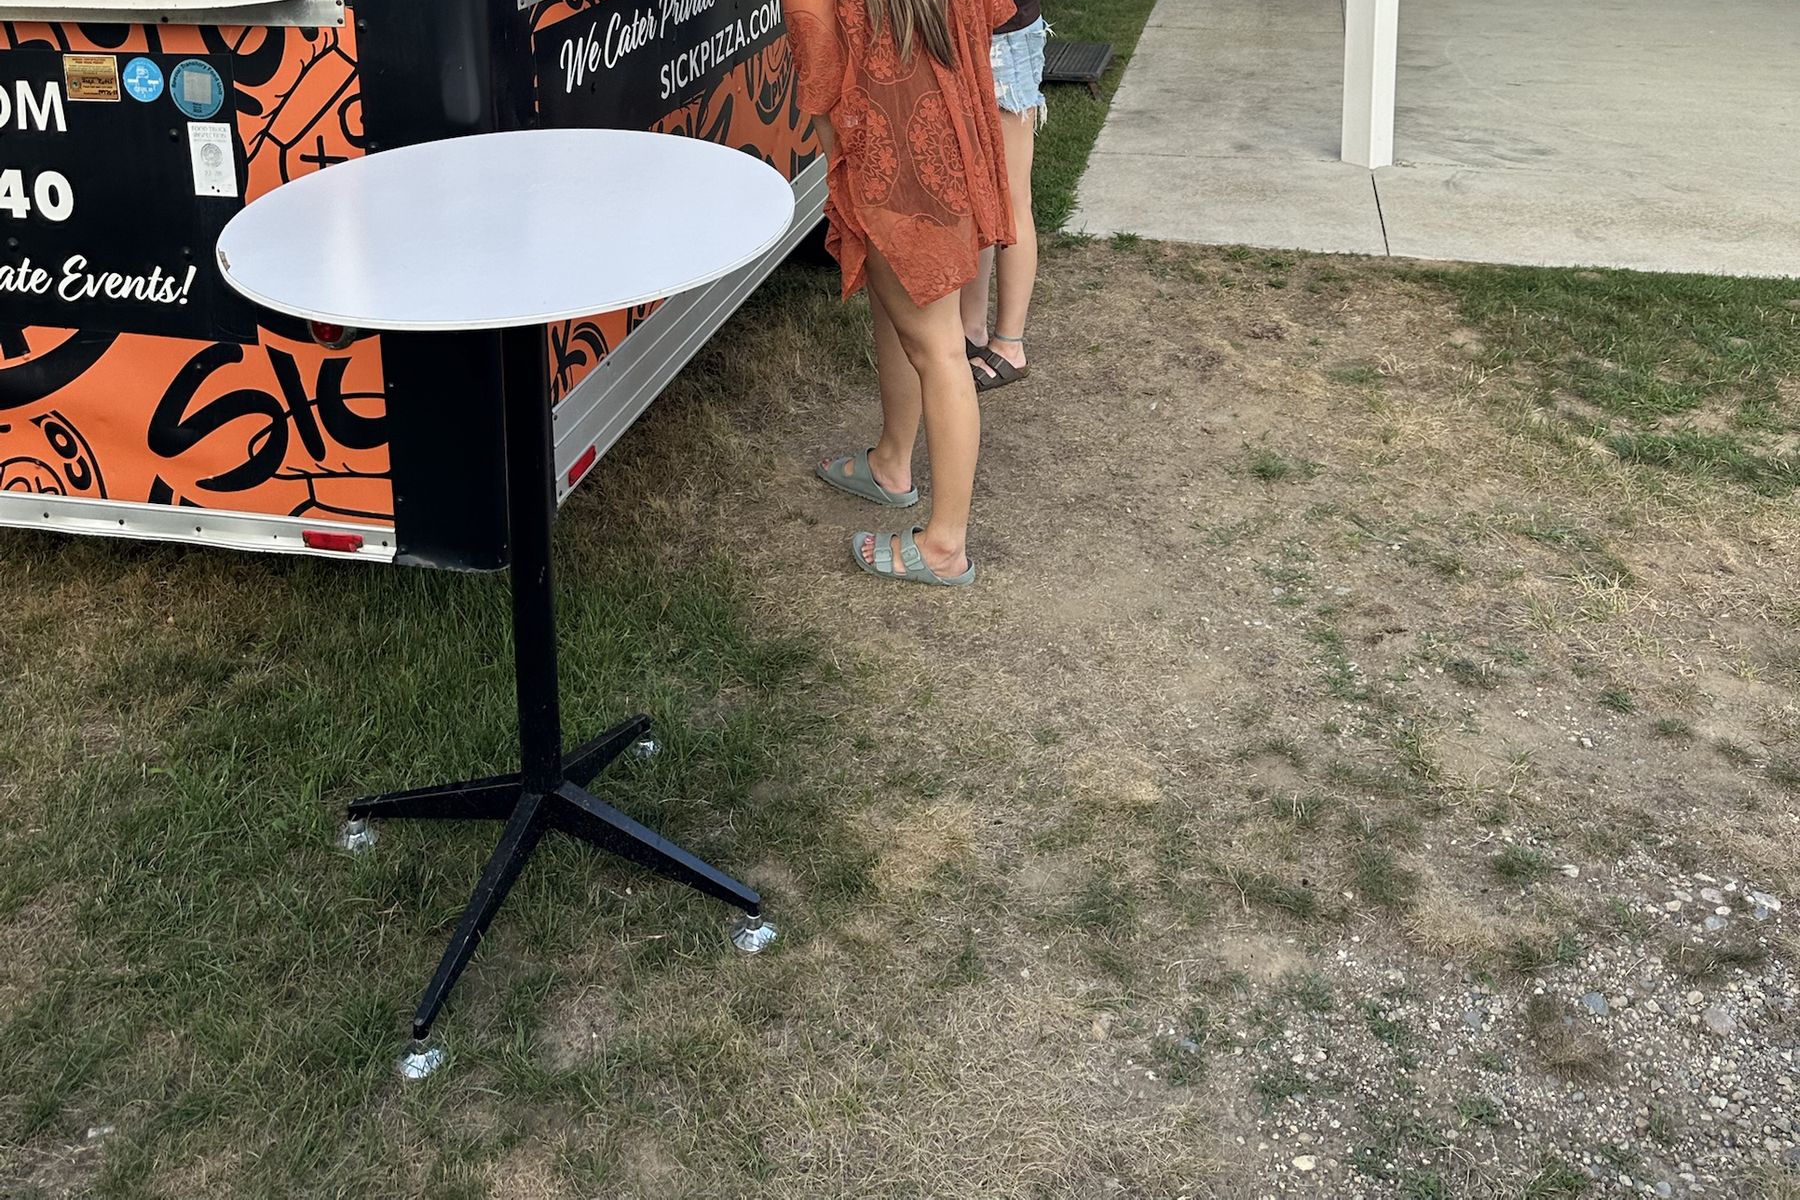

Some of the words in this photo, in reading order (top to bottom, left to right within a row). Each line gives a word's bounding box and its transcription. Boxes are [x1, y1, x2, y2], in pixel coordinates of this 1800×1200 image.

[560, 22, 601, 93] We
[604, 8, 657, 69] Cater
[0, 79, 67, 132] M
[58, 254, 197, 304] Events!
